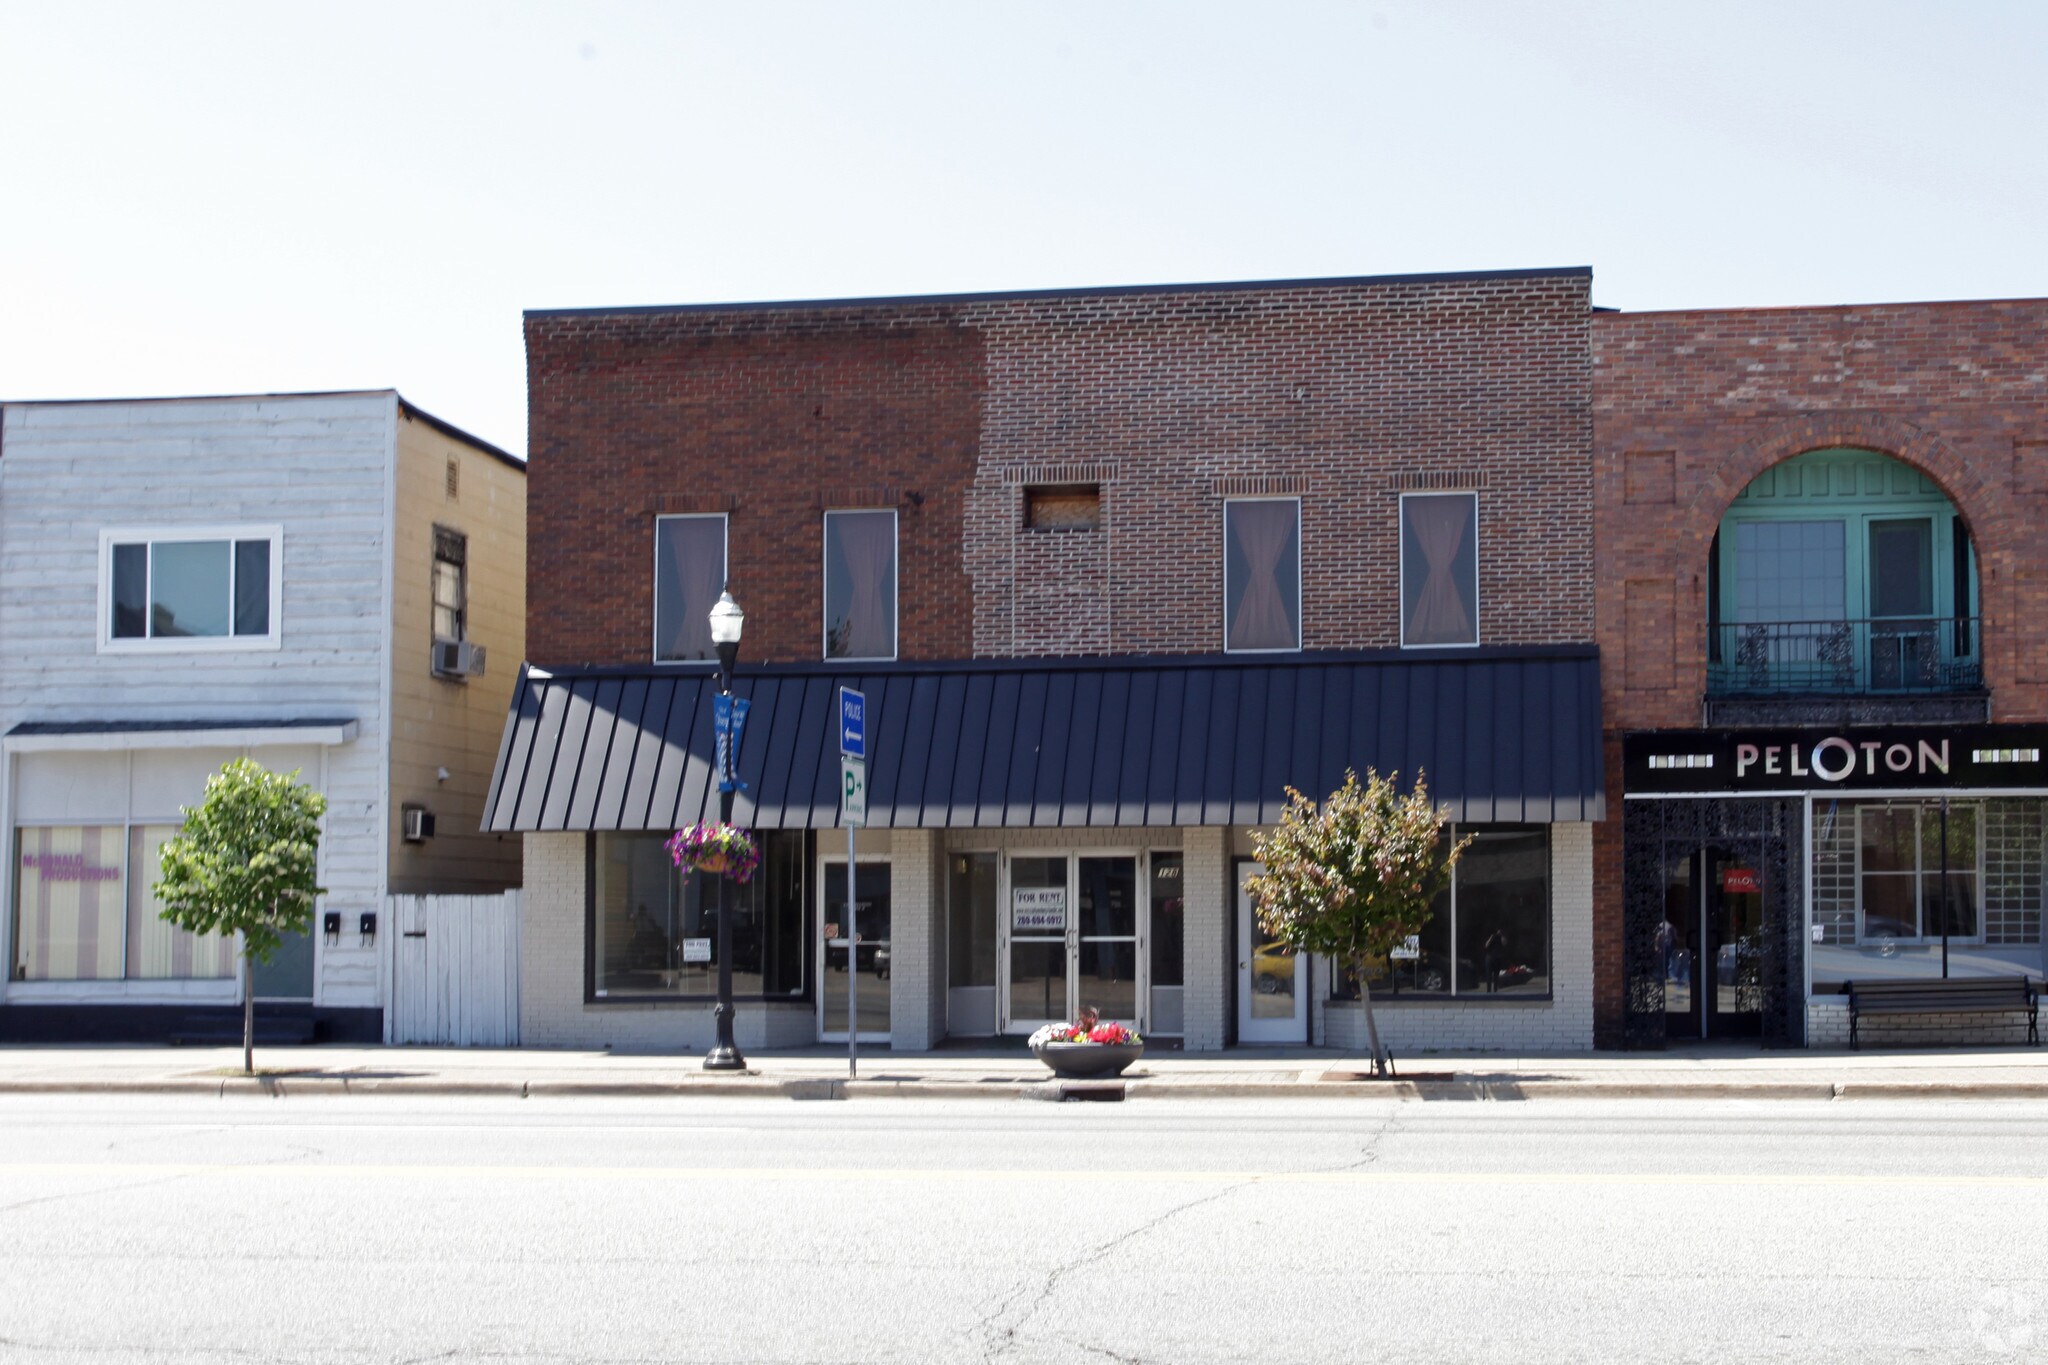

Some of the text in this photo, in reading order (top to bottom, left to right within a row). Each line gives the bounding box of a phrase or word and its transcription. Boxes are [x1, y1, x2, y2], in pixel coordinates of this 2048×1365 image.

[845, 701, 862, 721] POLICE
[1737, 736, 1949, 782] PELOTON
[41, 866, 119, 881] PRODUCTIONS
[1018, 892, 1060, 903] FOR RENT
